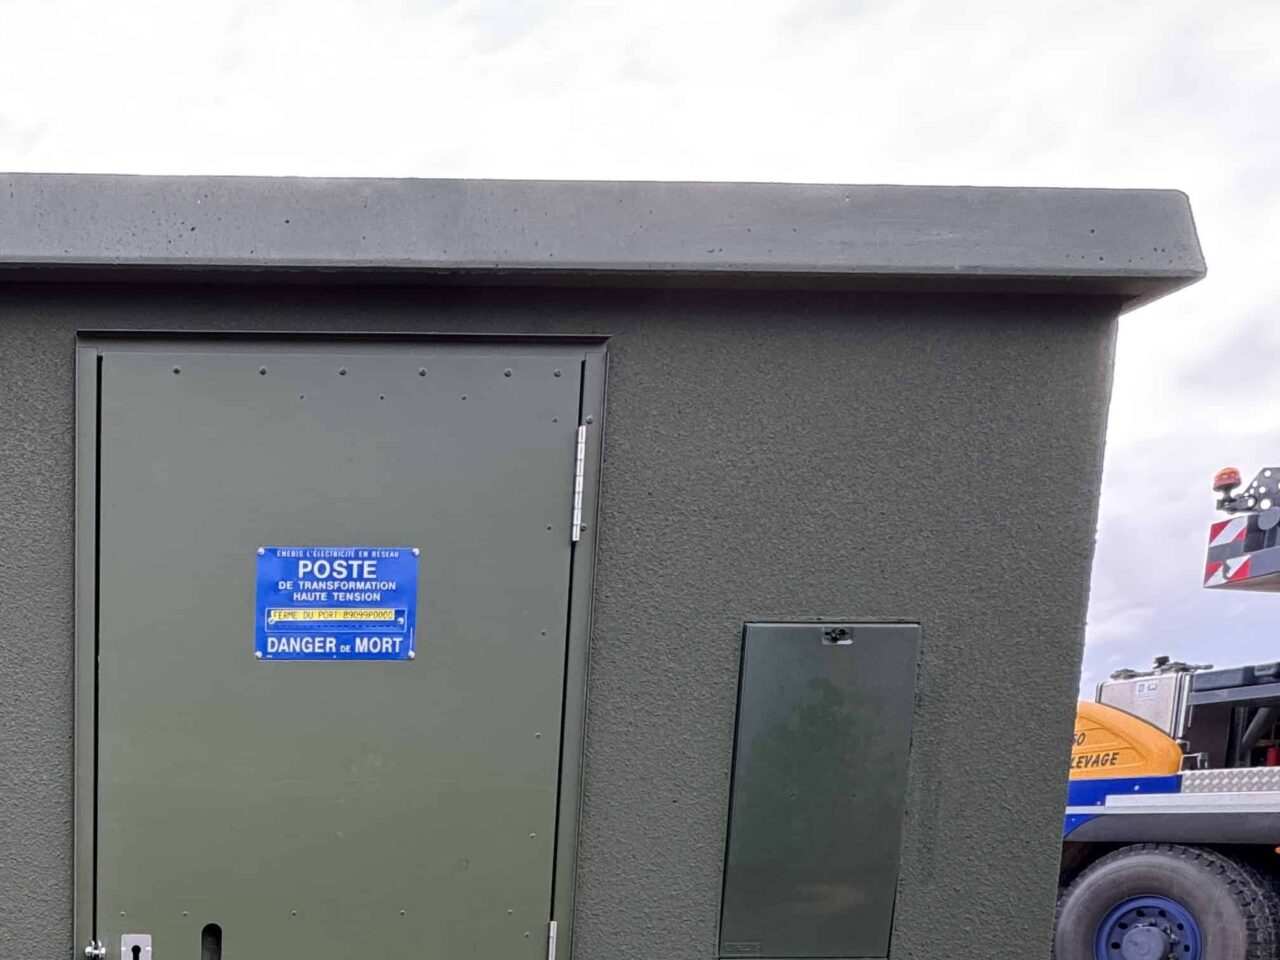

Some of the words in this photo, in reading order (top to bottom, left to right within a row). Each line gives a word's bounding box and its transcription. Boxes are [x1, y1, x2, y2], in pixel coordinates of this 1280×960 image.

[298, 559, 377, 579] POSTE
[278, 581, 293, 590] DE
[299, 581, 396, 590] TRANSFORMATION
[293, 592, 328, 601] HAUTE
[332, 592, 381, 601] TENSION
[273, 611, 297, 619] FERME
[303, 611, 313, 619] DU
[318, 611, 338, 619] PORT
[267, 637, 337, 653] DANGER
[340, 645, 351, 653] DE
[355, 637, 403, 653] MORT
